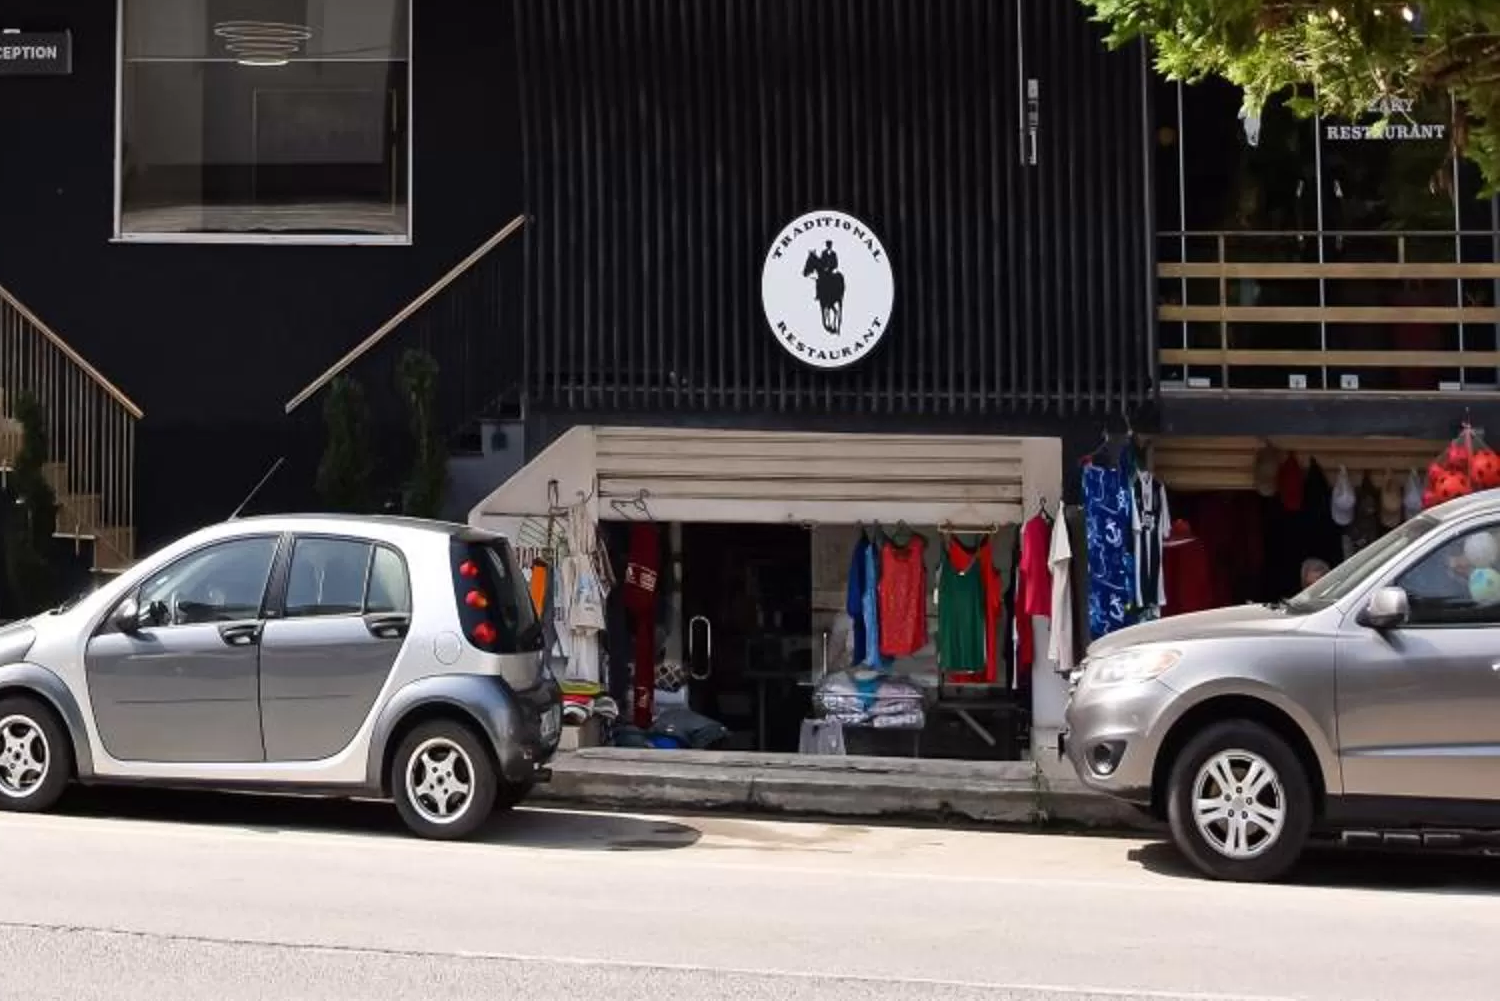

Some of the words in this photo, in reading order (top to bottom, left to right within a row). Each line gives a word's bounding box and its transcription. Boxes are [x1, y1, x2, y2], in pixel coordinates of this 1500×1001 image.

[1327, 124, 1445, 140] RESTURANT
[772, 216, 883, 263] TRADITIONAL
[776, 316, 883, 360] RESTAURANT
